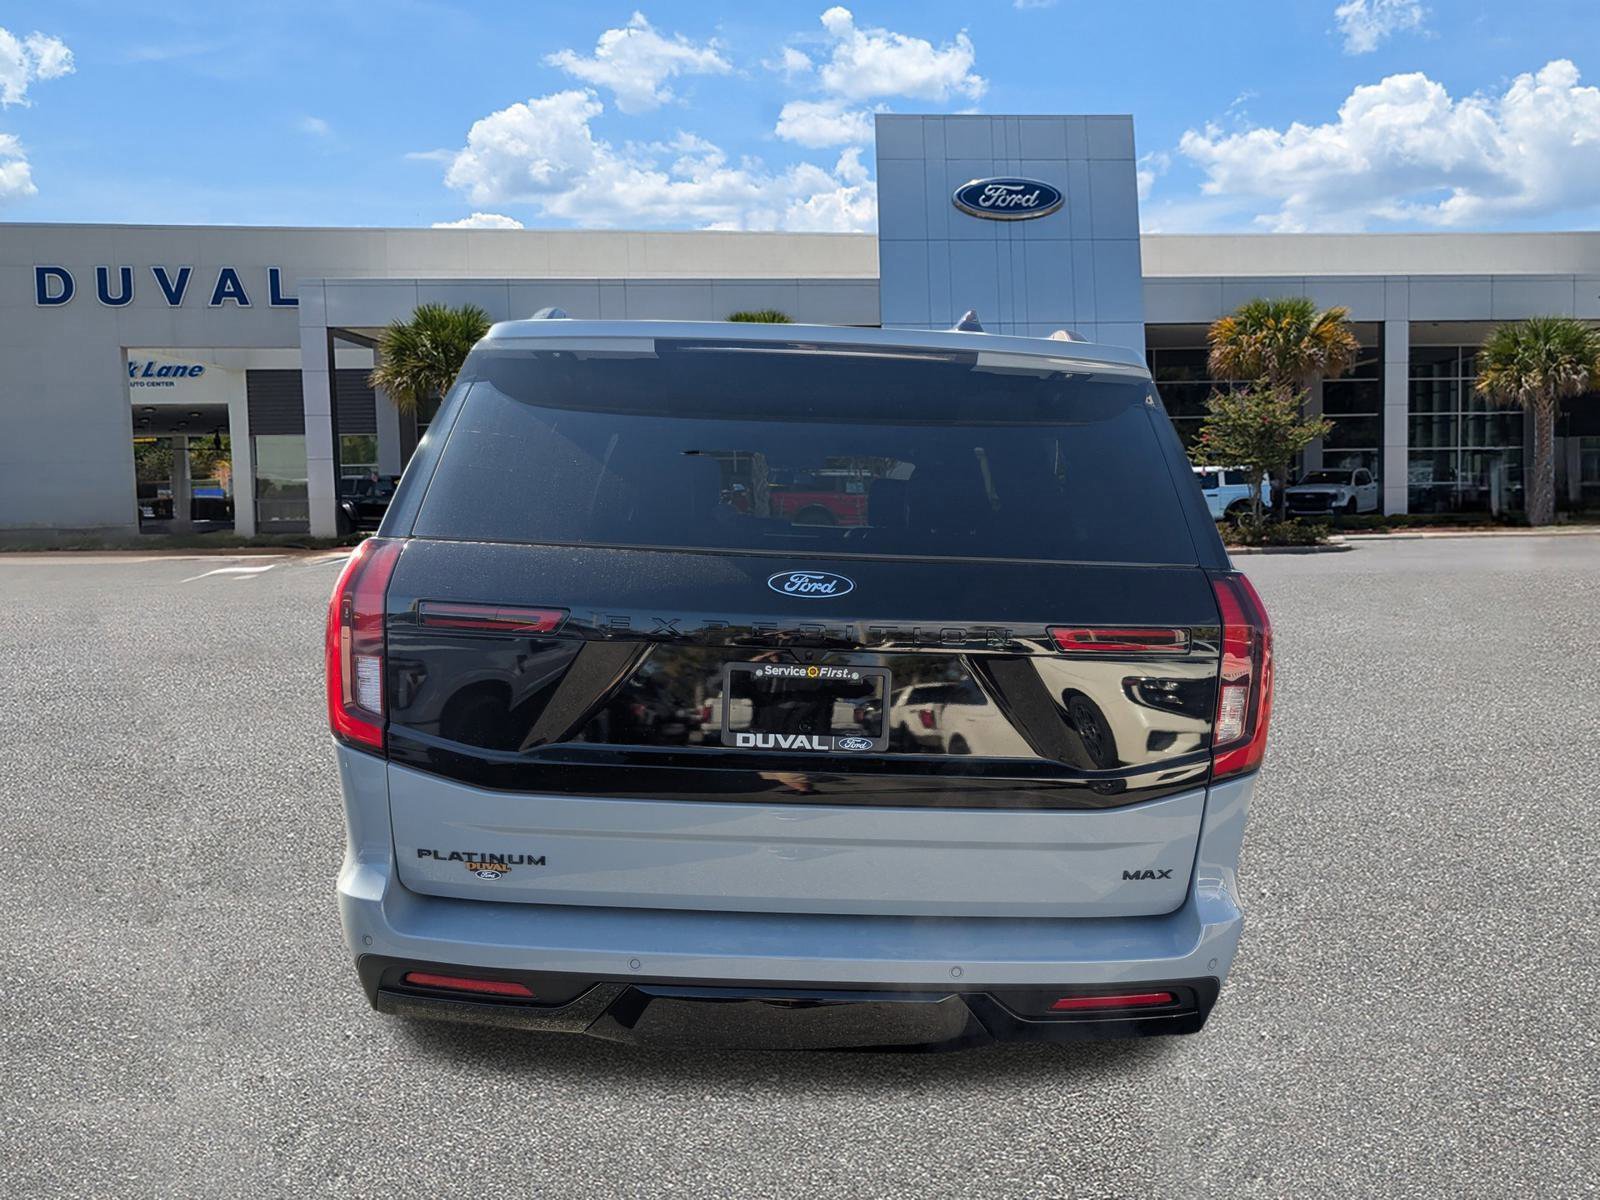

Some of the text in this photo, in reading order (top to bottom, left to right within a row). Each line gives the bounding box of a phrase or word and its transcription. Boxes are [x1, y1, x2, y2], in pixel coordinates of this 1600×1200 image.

[978, 184, 1040, 207] Ford
[33, 265, 300, 308] DUVAL
[141, 361, 204, 378] Lane
[784, 573, 837, 593] Ford
[605, 615, 1014, 647] EXPEDITION
[764, 665, 807, 676] Service
[736, 733, 867, 750] DUVAL Ford
[416, 848, 547, 866] PLATINUM
[466, 862, 511, 873] DUVAL
[1122, 869, 1173, 881] MAX
